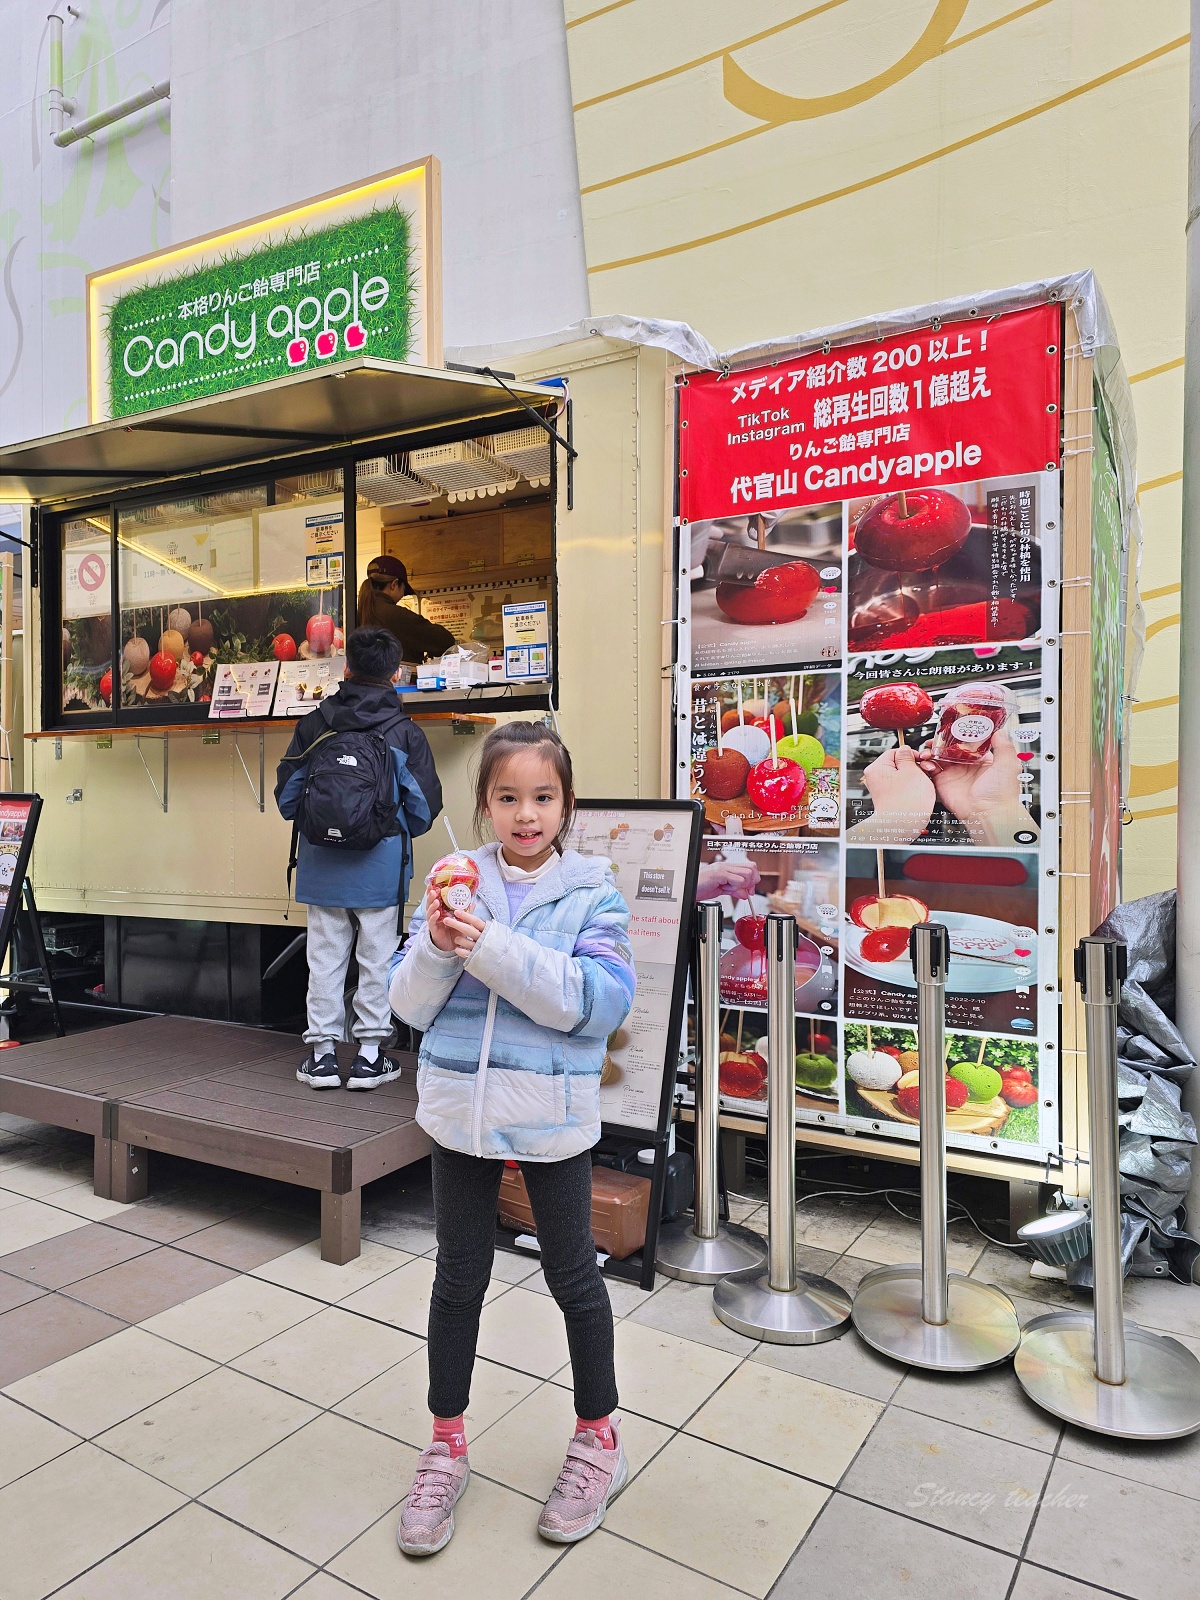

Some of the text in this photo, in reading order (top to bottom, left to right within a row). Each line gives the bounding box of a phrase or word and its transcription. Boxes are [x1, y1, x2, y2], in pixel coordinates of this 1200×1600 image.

[177, 260, 321, 321] 本格りんご飴専門店
[123, 270, 390, 378] Candy apple
[731, 355, 868, 404] メディア紹介数
[872, 343, 922, 374] 200
[737, 406, 790, 428] TikTok
[727, 421, 805, 446] Instagram
[789, 423, 911, 461] りんご飴専門店
[730, 440, 982, 504] 代官山 Candyapple
[853, 661, 1033, 680] 今回皆さんに朗報があります！
[691, 698, 708, 801] 昔とは違うん
[0, 809, 27, 818] ndyapple
[720, 809, 763, 820] Candy
[643, 871, 665, 880] This store
[641, 885, 657, 893] doesn't
[629, 914, 679, 924] he staff about
[640, 928, 660, 937] items
[880, 990, 906, 998] Candy
